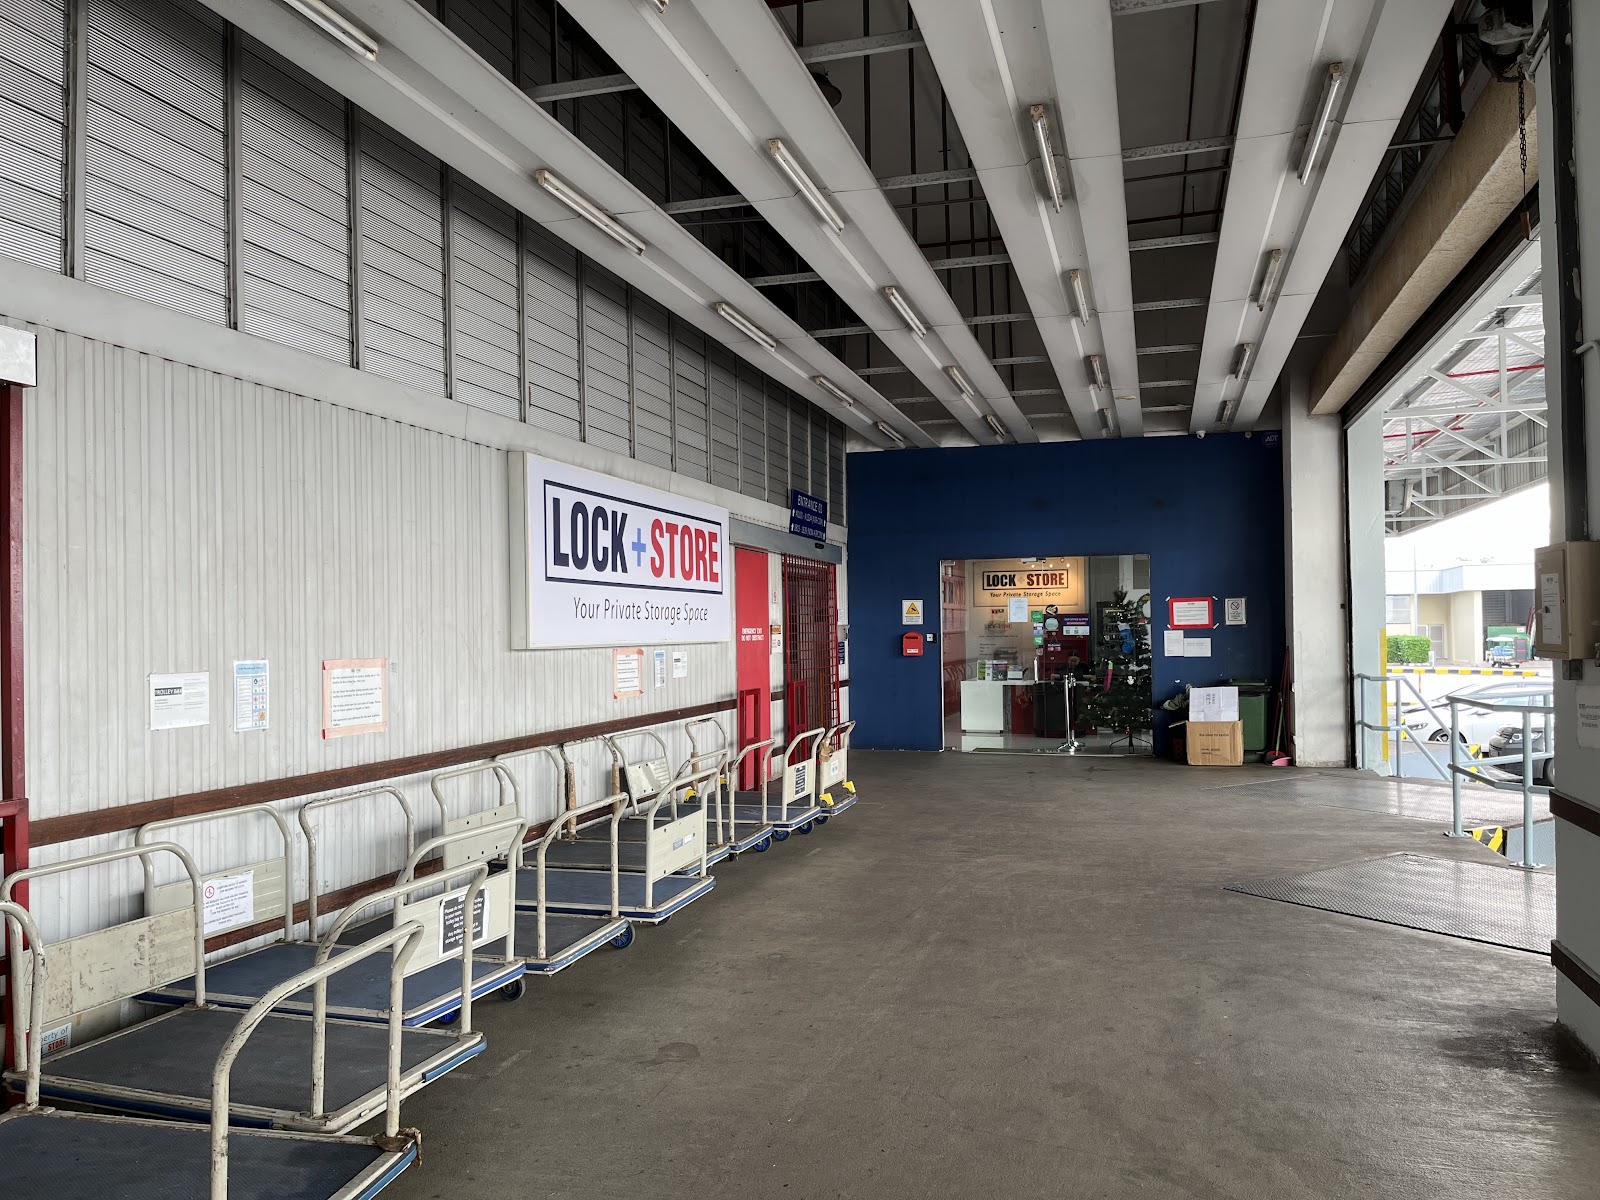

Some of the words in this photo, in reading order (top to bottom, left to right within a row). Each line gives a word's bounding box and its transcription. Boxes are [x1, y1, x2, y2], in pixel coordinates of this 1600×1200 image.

[797, 494, 818, 512] ENTRANCE
[552, 497, 628, 573] LOCK
[650, 518, 719, 583] STORE
[986, 573, 1017, 587] LOCK
[1026, 572, 1065, 586] STORE
[573, 596, 600, 620] Your
[604, 598, 641, 621] Private
[644, 600, 681, 625] Storage
[684, 603, 708, 626] Space
[155, 688, 173, 696] TROLLEY
[60, 1026, 69, 1035] of
[47, 1037, 67, 1051] STORE
